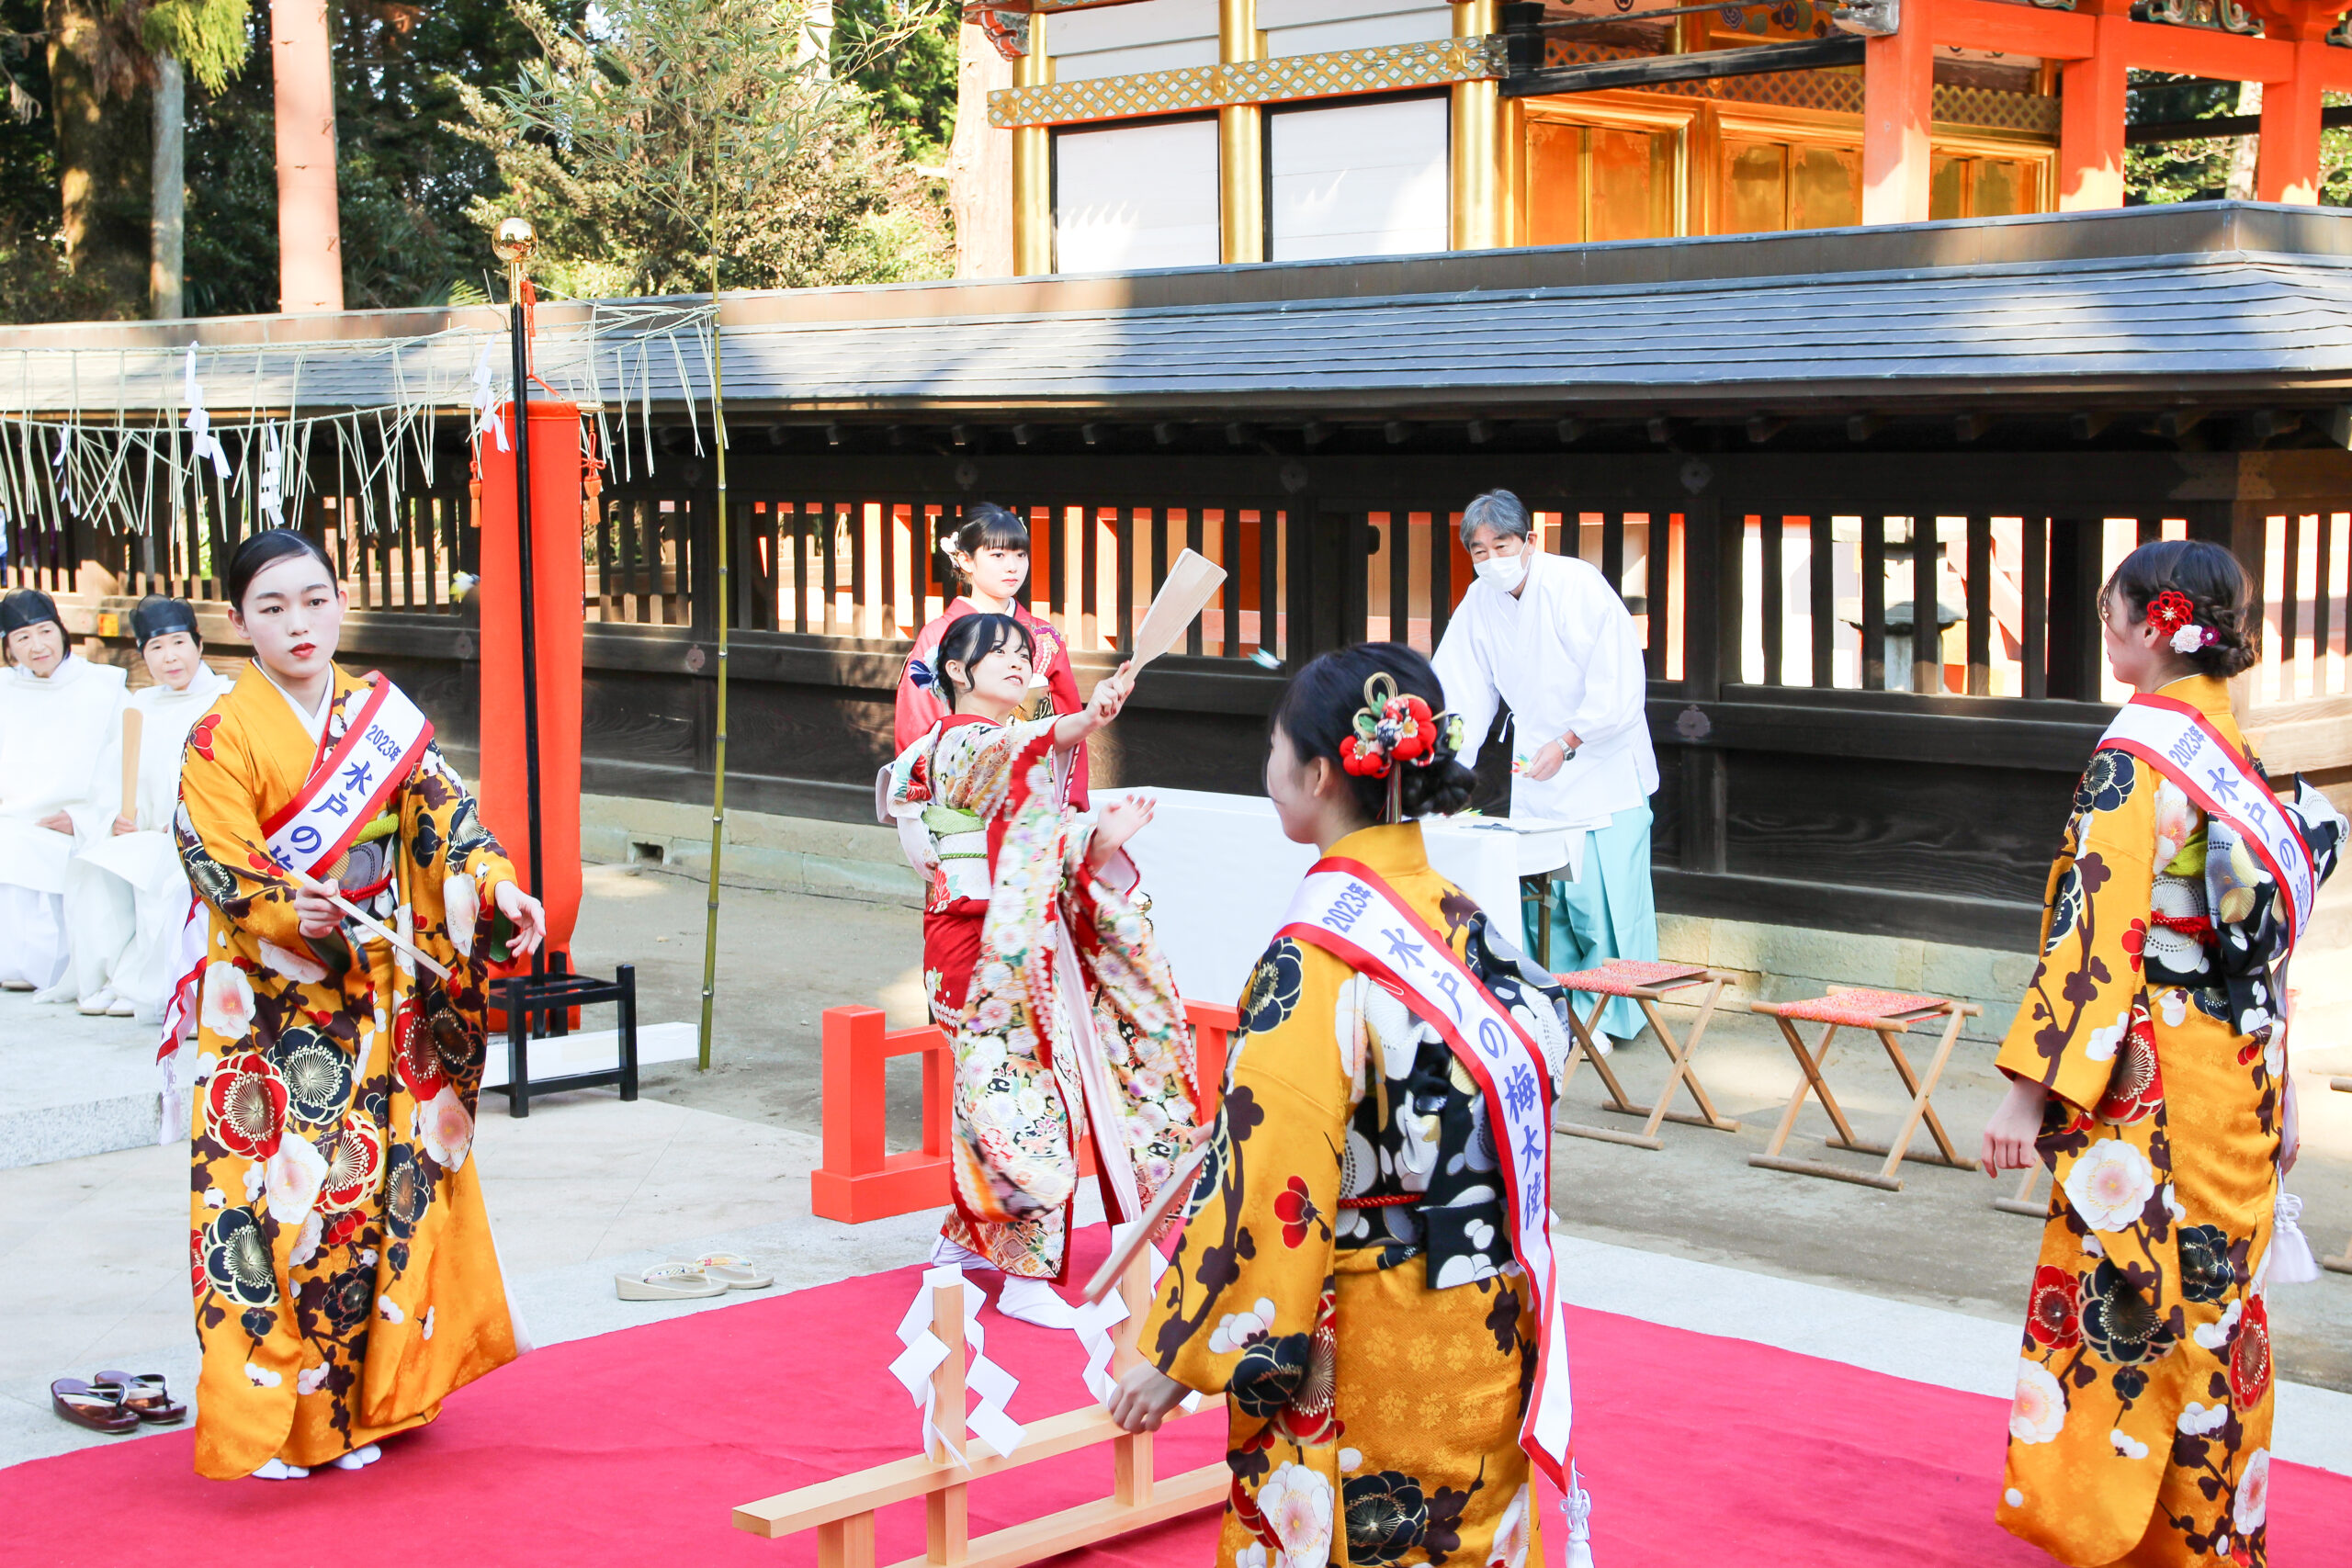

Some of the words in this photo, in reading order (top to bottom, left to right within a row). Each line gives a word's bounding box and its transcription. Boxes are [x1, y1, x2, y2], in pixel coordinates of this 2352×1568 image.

[365, 724, 402, 762] 2023年
[2168, 725, 2208, 768] 2023年
[2207, 766, 2311, 940] 水戸の梅
[1322, 882, 1374, 933] 2023年
[1380, 926, 1544, 1231] 水戸の梅大使
